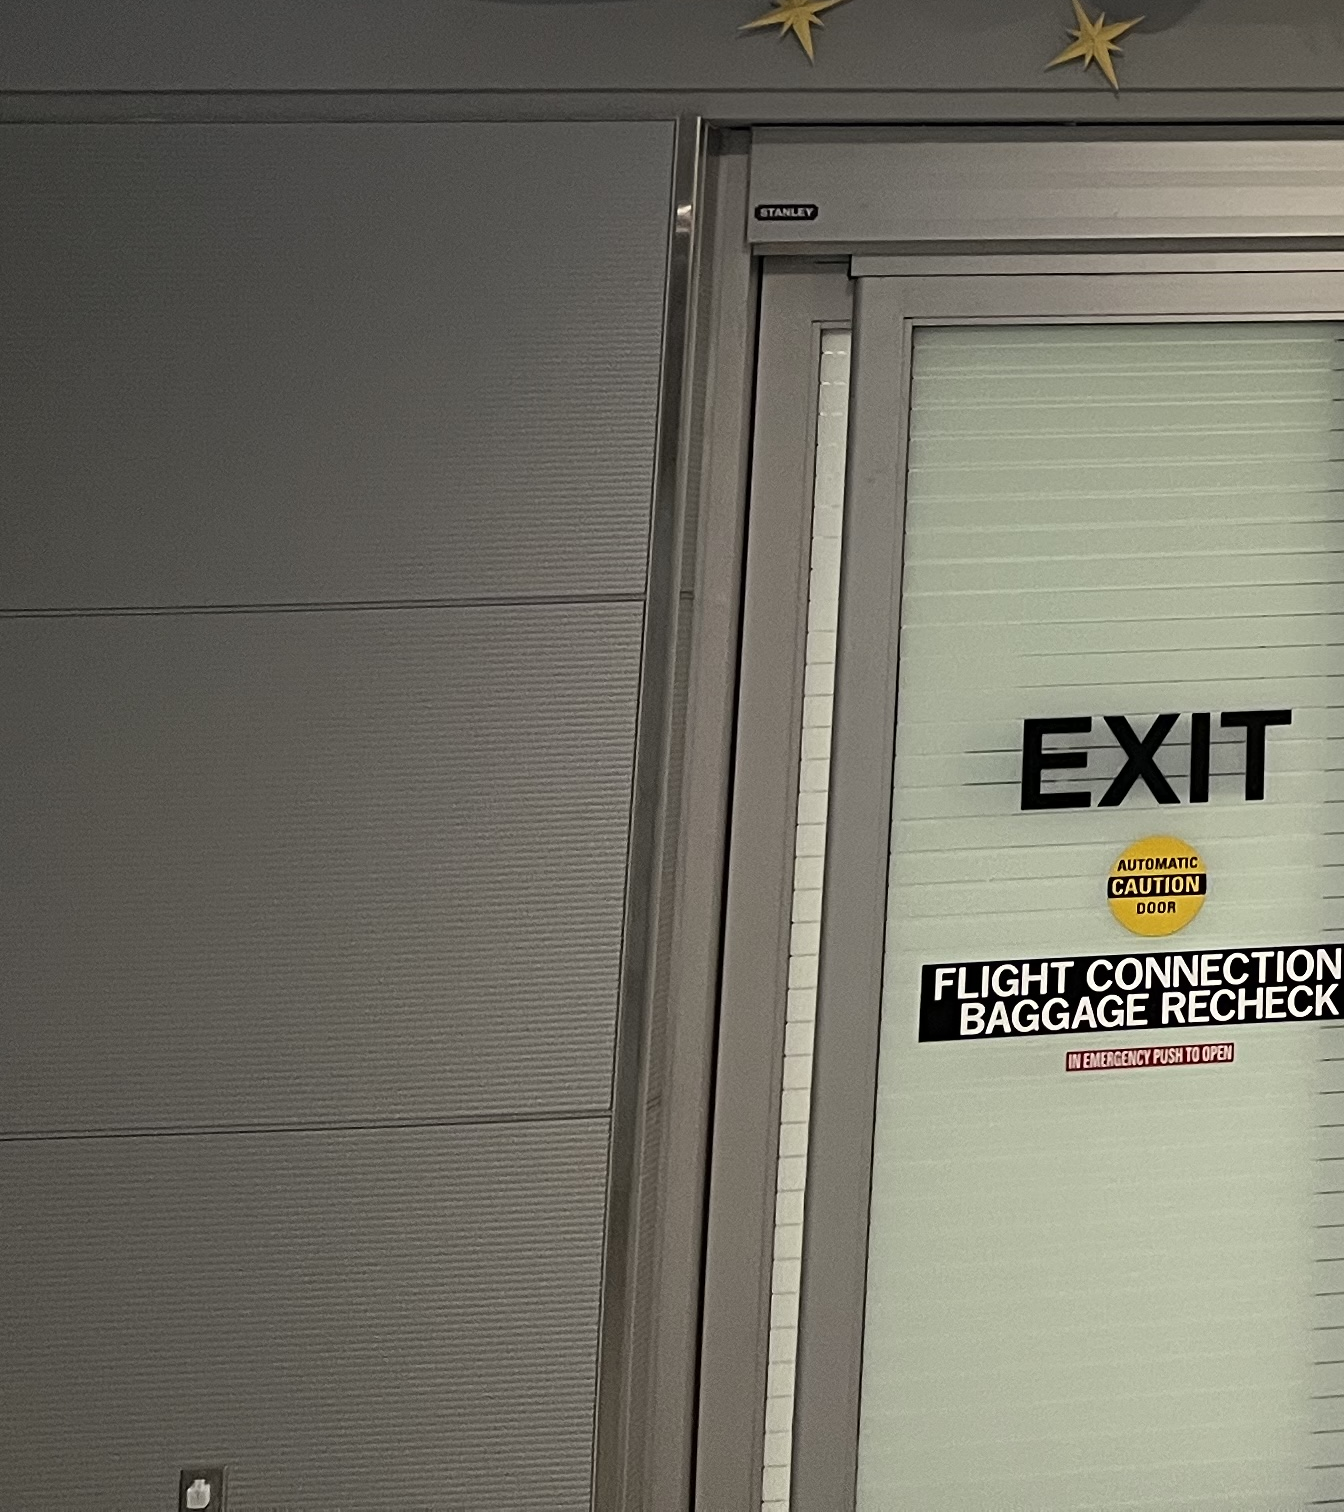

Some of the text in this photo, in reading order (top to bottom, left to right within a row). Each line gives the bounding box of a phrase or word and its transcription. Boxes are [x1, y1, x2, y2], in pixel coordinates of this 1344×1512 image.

[760, 207, 814, 218] STANLEY
[1020, 709, 1292, 811] EXIT
[1117, 857, 1198, 872] AUTOMATIC
[1111, 875, 1200, 895] CAUTION
[1136, 901, 1176, 914] DOOR
[934, 961, 1075, 1001] FLIGHT
[959, 983, 1340, 1036] BAGGAGE RECHECK
[1068, 1045, 1233, 1069] IN EMERGENCY PUSH TO OPEN
